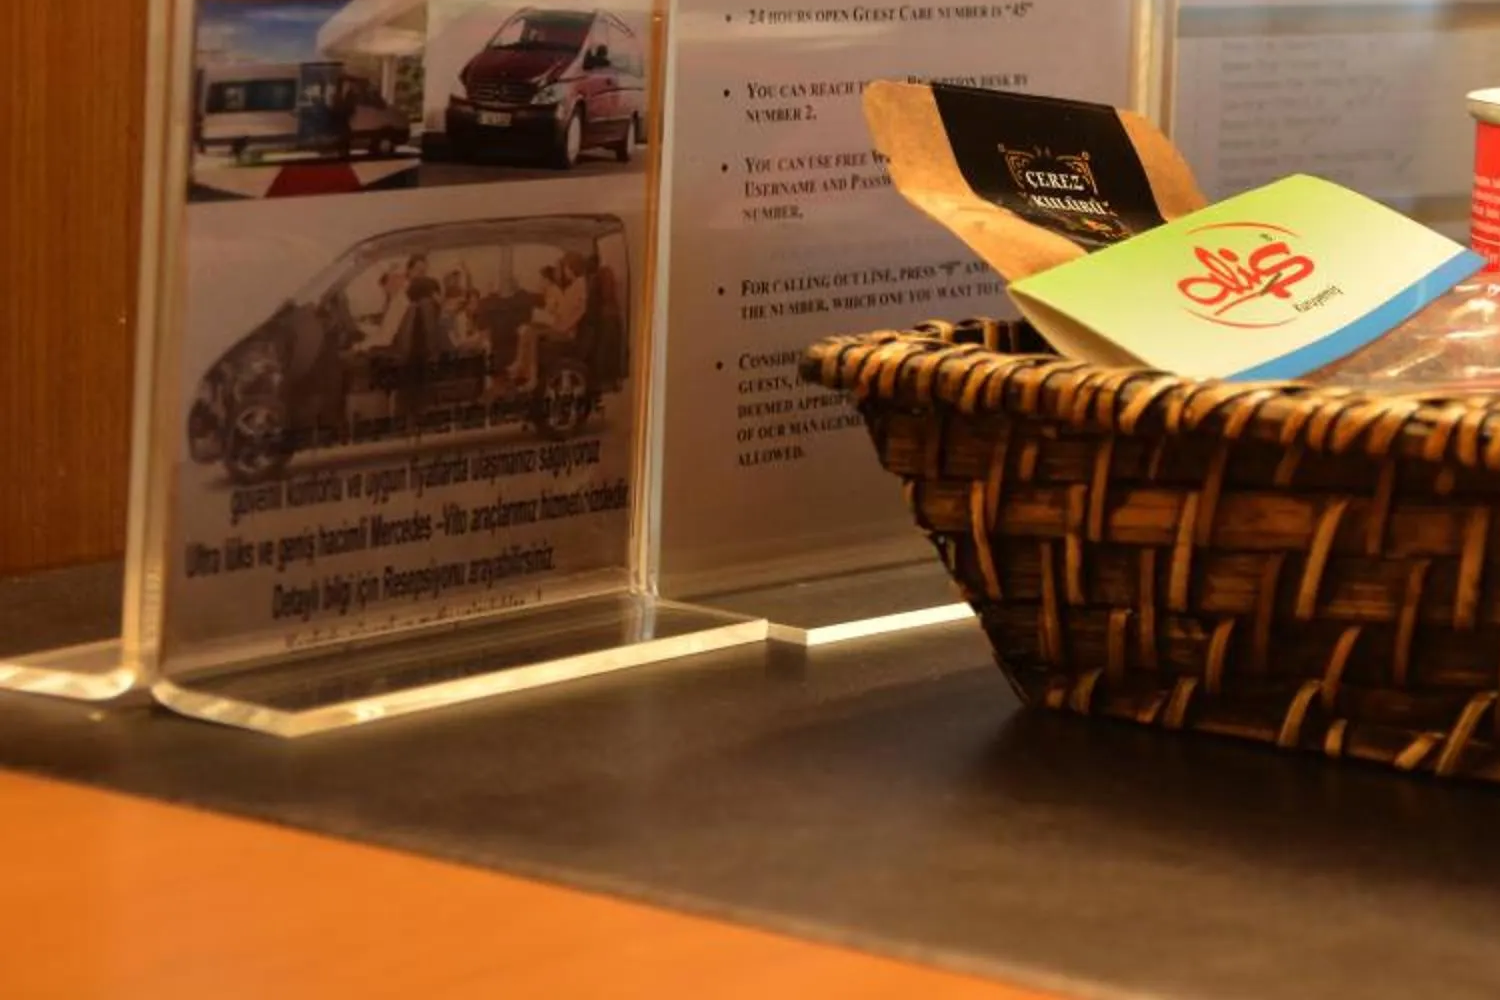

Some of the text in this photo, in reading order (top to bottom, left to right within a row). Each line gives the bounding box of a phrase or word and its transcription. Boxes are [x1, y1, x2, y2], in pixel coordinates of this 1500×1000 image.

[768, 9, 811, 24] HOURS
[815, 9, 849, 22] OPEN
[937, 5, 988, 18] NUMBER
[779, 84, 806, 97] CAN
[747, 107, 801, 122] NUMBER
[777, 157, 805, 171] CAN
[809, 156, 832, 168] USE
[835, 153, 867, 167] FREE
[823, 178, 847, 192] AND
[743, 204, 803, 222] NUMBER.
[772, 274, 831, 293] CALLING
[900, 265, 936, 281] PRESS
[741, 304, 767, 320] THE
[770, 301, 829, 318] NUMBER,
[832, 296, 878, 310] WHICH
[880, 293, 905, 306] ONE
[909, 290, 932, 303] YOU
[937, 284, 973, 299] WANT
[738, 377, 793, 394] GUESTS,
[738, 400, 793, 418] DEEMED
[737, 427, 754, 441] OF
[758, 424, 786, 439] OUR
